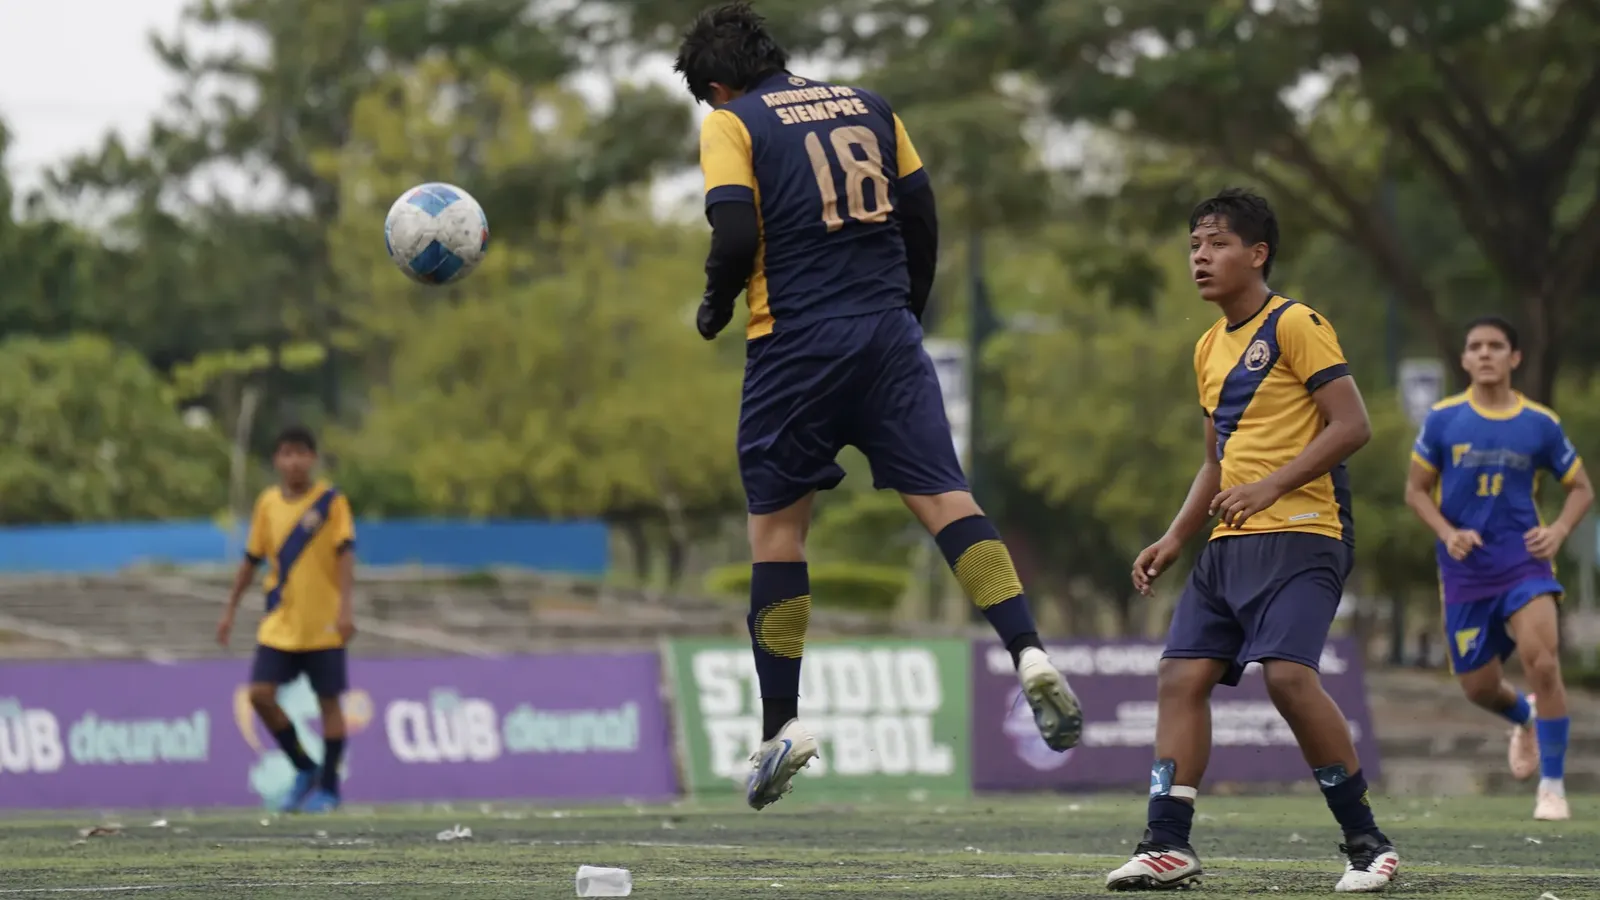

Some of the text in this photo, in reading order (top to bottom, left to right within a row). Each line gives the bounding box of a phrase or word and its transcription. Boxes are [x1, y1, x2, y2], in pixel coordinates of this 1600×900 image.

[775, 97, 869, 125] SIEMPRE
[804, 125, 893, 232] 18
[0, 708, 64, 772] UB
